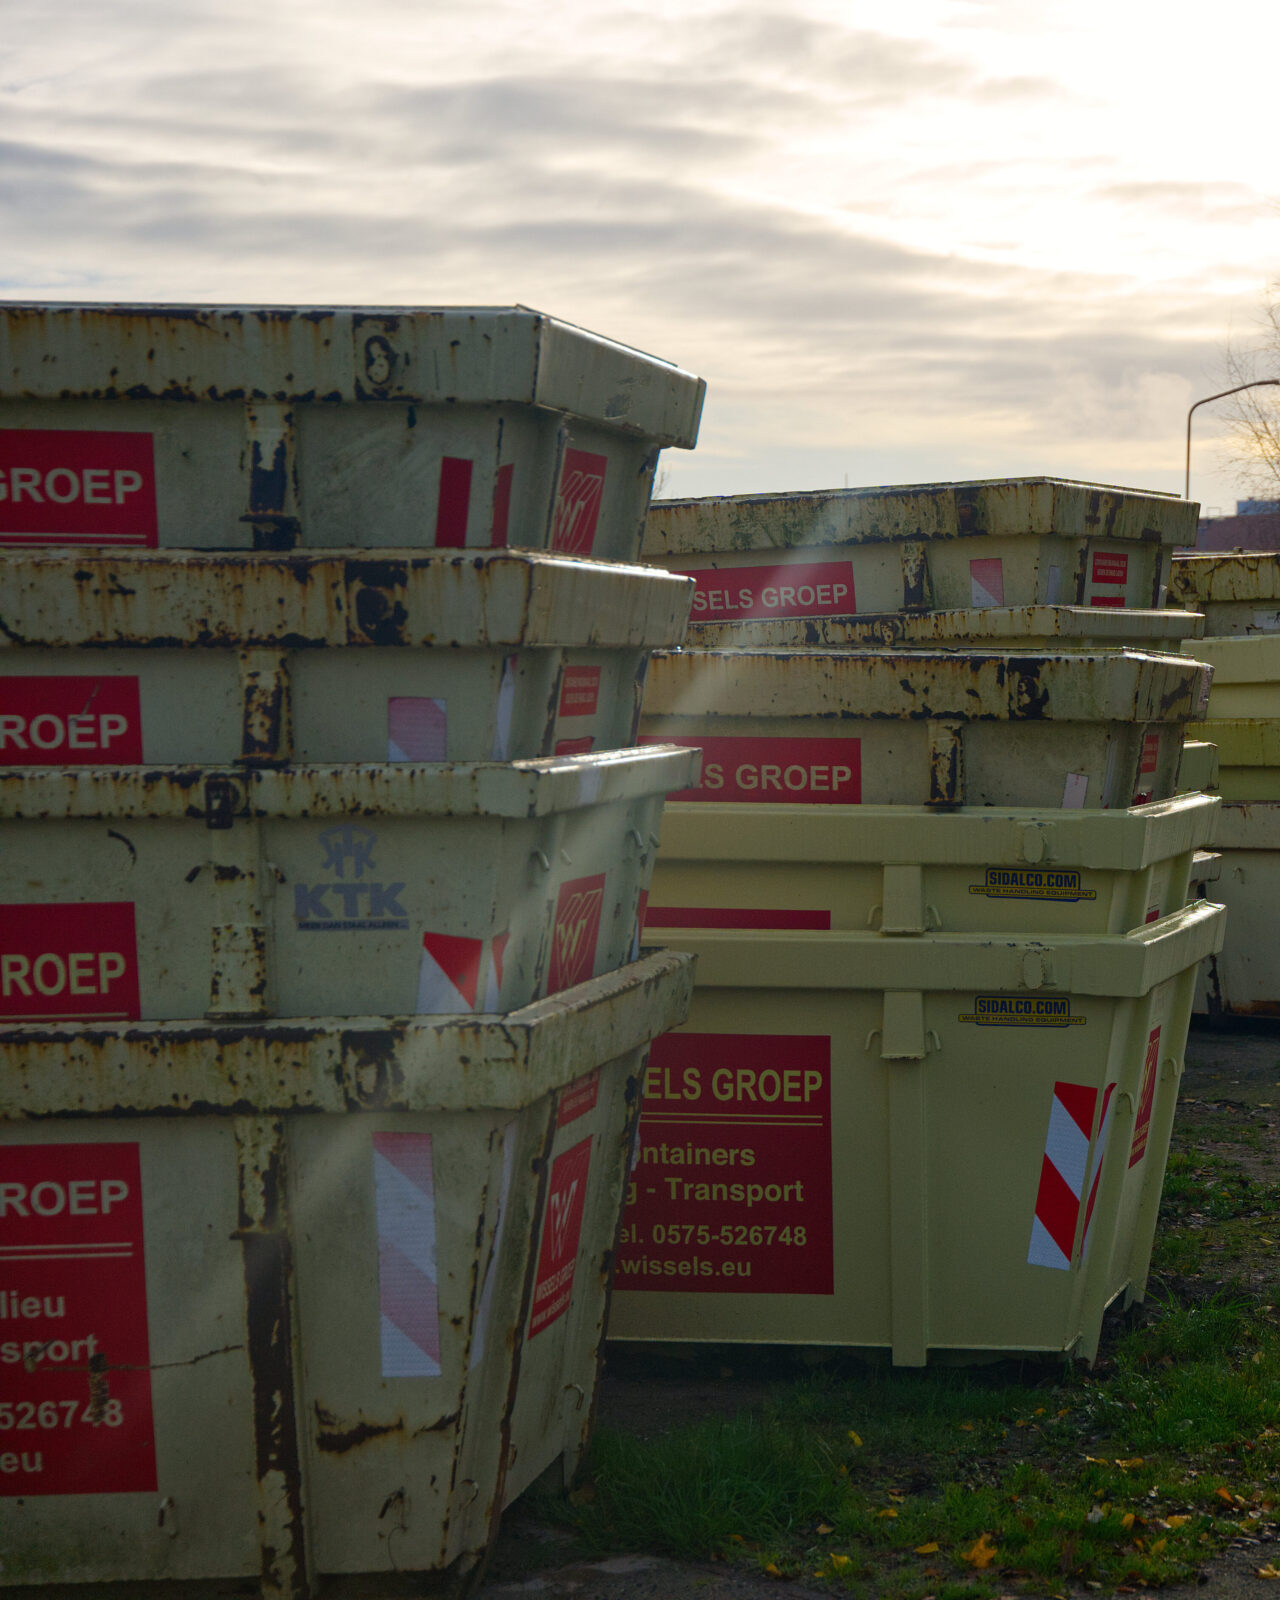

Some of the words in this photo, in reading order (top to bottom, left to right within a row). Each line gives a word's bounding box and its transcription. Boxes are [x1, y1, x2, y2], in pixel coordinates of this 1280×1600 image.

[0, 467, 143, 504] ROEP
[761, 583, 848, 608] GROEP
[735, 763, 852, 791] GROEP
[989, 871, 1077, 889] SIDALCO.COM
[294, 882, 408, 918] KTK
[1, 952, 126, 996] ROEP
[978, 999, 1067, 1015] SIDALCO.COM
[711, 1068, 823, 1103] GROEP
[637, 1141, 756, 1167] ntainers
[664, 1177, 804, 1208] Transport
[652, 1224, 807, 1247] 0575-526748
